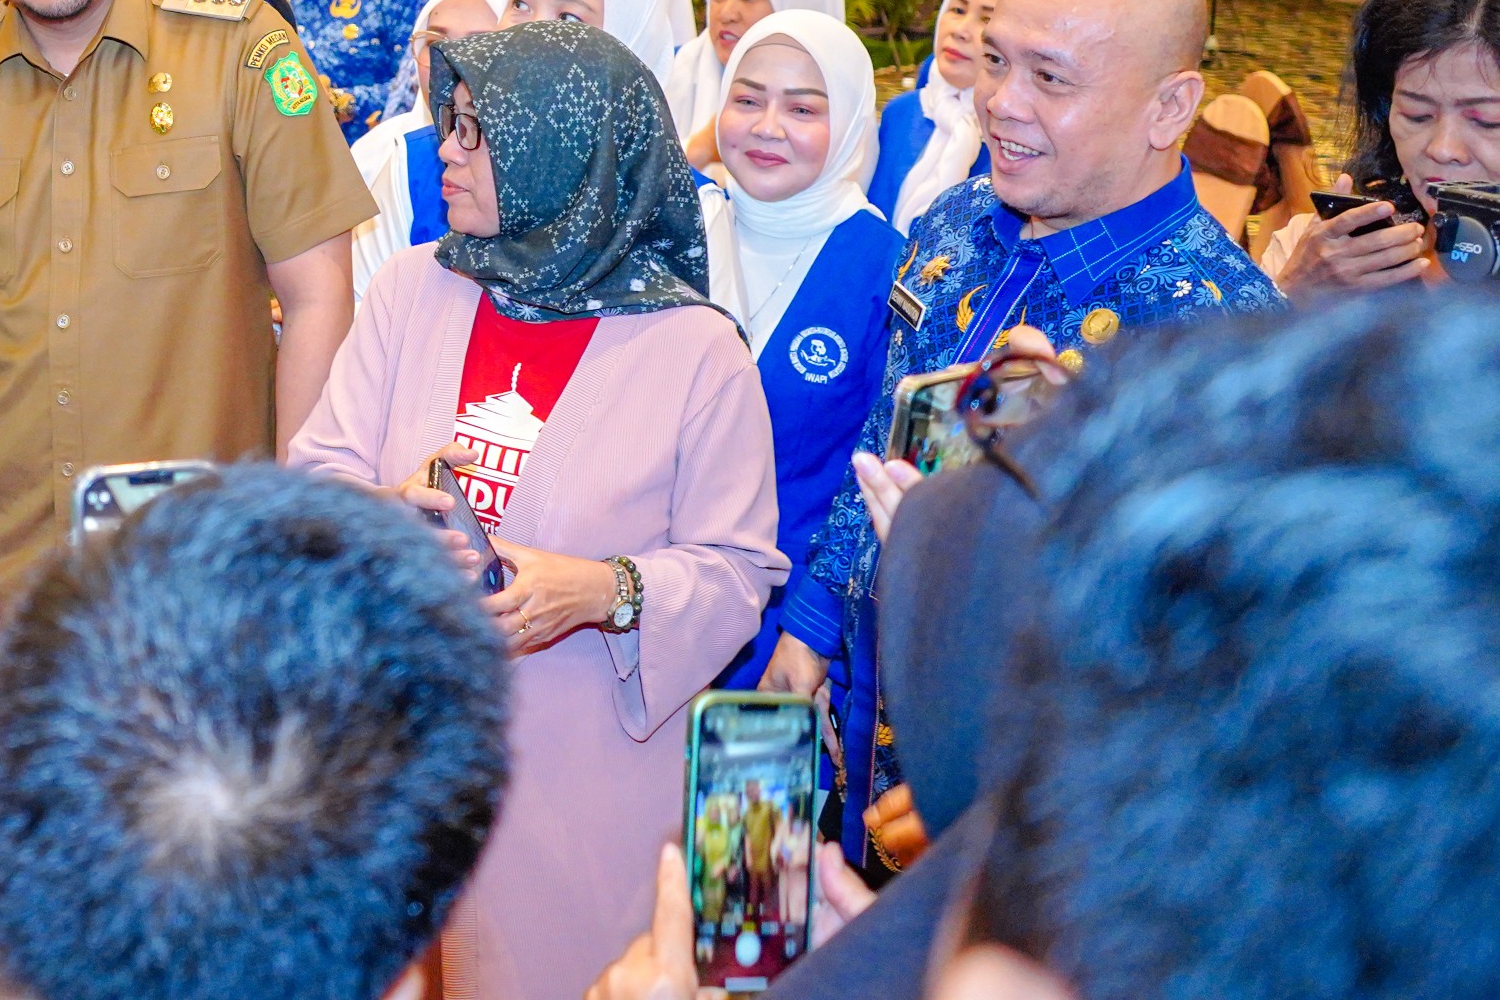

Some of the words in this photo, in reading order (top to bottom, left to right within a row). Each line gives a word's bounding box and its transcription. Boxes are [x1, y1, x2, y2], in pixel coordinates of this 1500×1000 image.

[251, 44, 268, 66] PEMKO
[266, 33, 287, 45] MEDAN
[1450, 249, 1469, 264] DV
